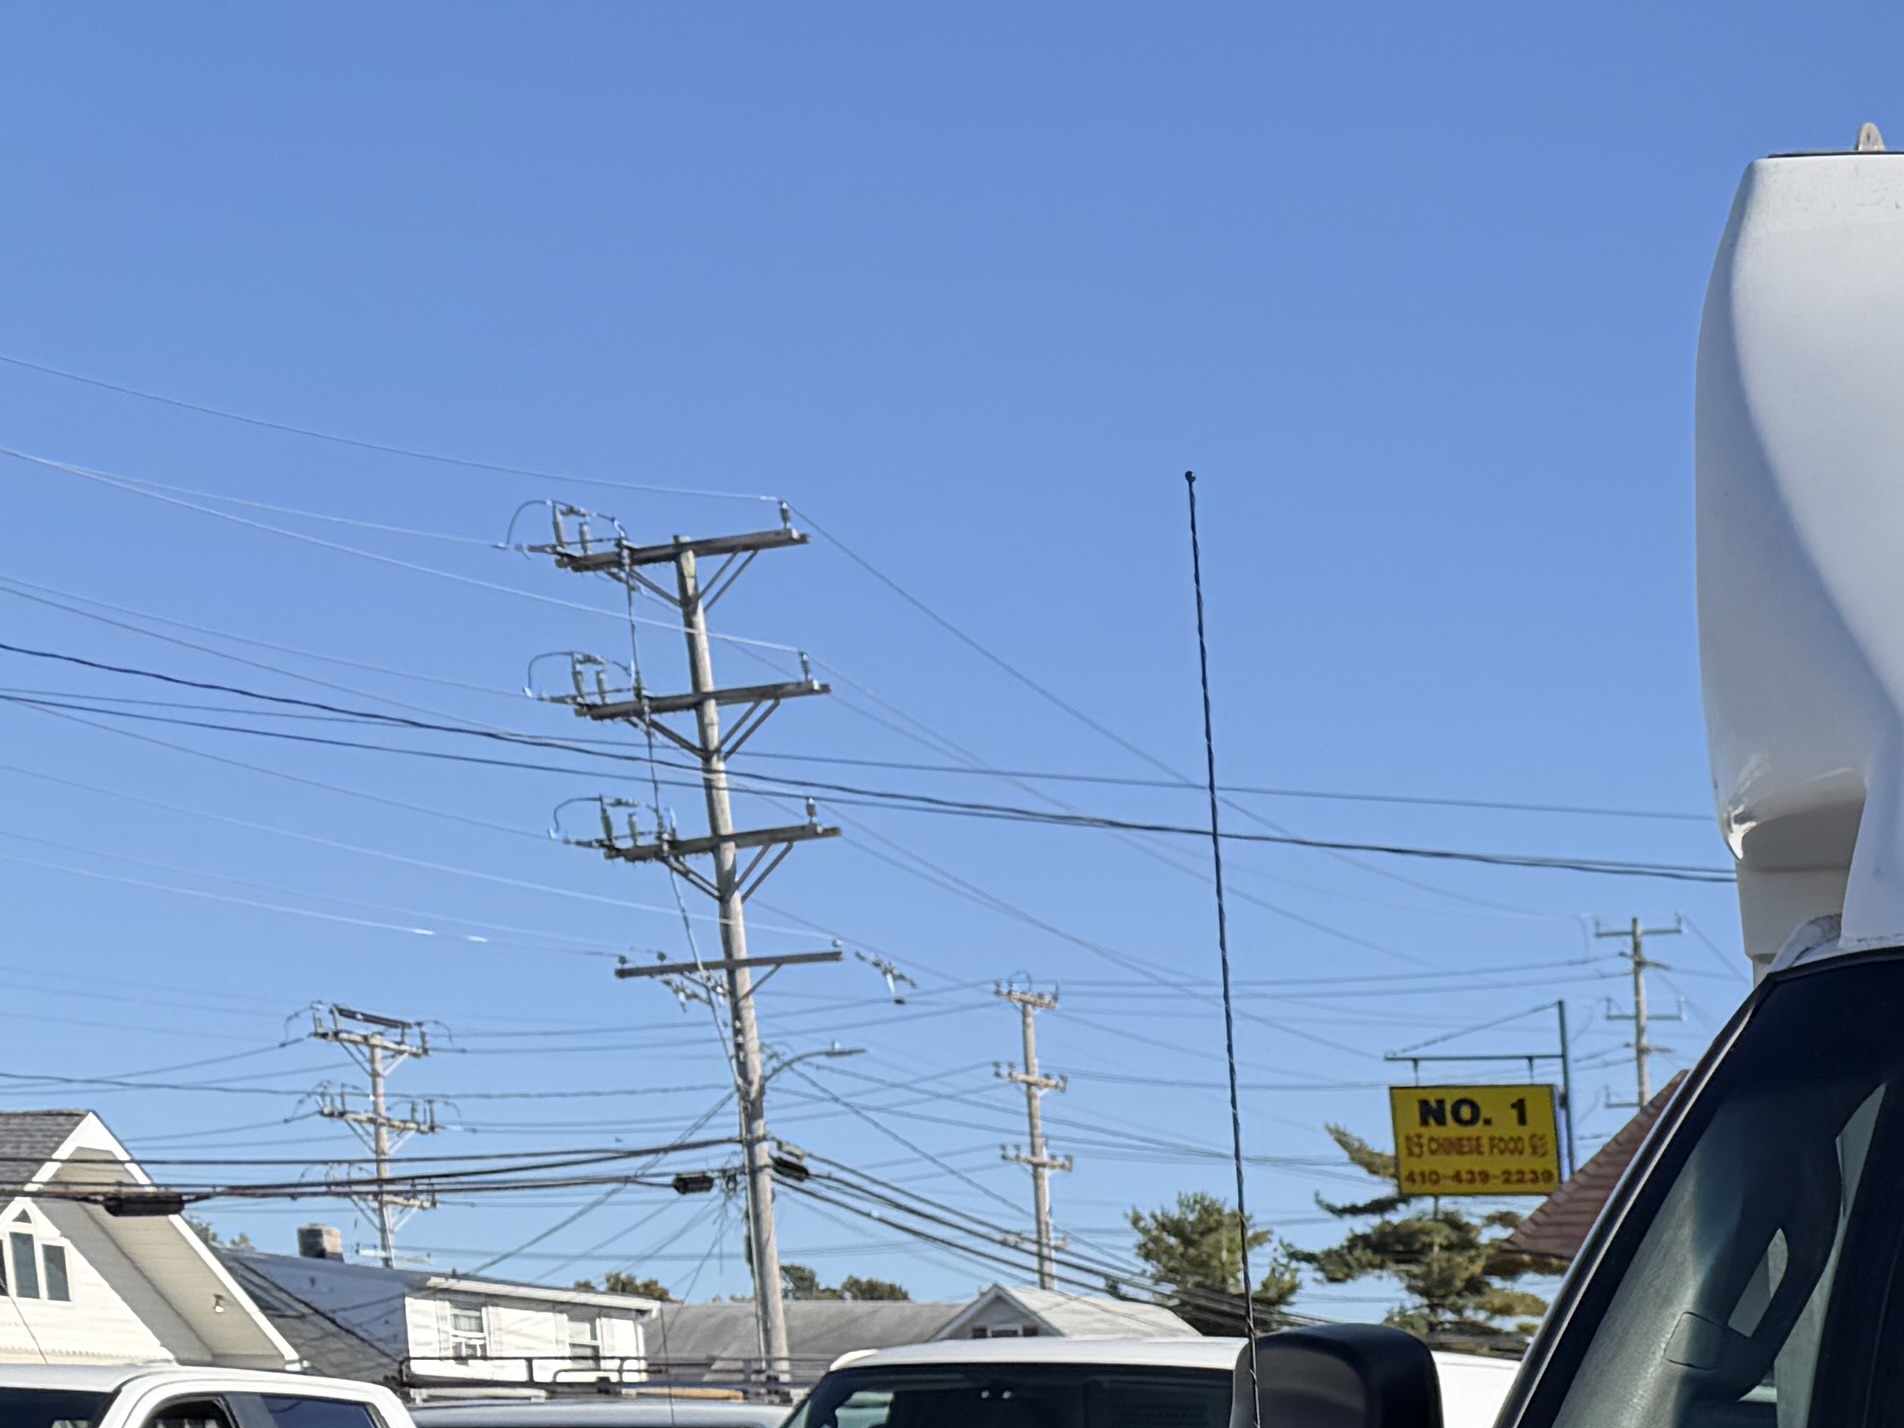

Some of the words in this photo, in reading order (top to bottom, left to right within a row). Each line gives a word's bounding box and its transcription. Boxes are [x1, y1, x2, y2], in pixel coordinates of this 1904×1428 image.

[1417, 1097, 1492, 1127] NO.
[1510, 1097, 1528, 1126] 1
[1428, 1136, 1484, 1157] CHINESE
[1489, 1136, 1525, 1156] FOOD
